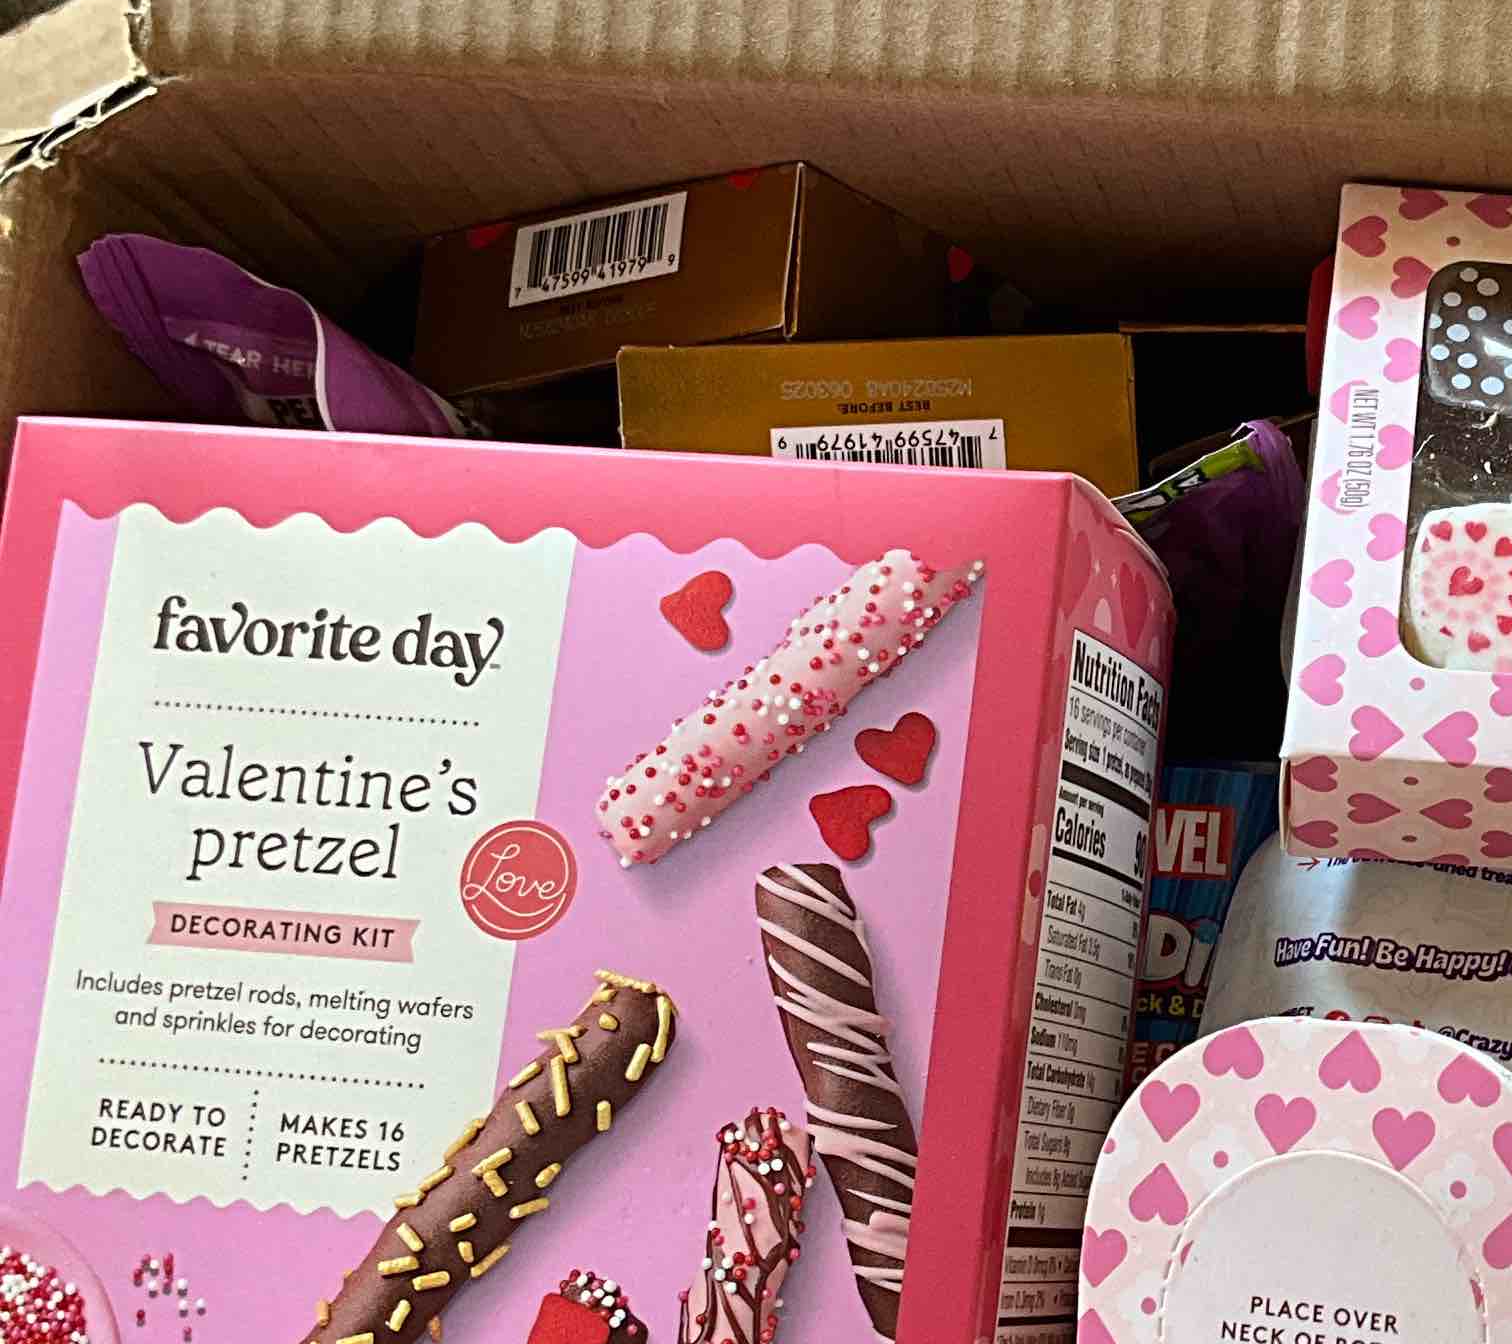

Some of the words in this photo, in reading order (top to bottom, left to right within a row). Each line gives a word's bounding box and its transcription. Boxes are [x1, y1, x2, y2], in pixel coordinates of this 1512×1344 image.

[273, 358, 316, 379] HE
[1353, 388, 1379, 410] NET
[1352, 413, 1376, 430] WT
[1348, 435, 1375, 458] 1.76
[1346, 461, 1372, 476] OZ
[1340, 478, 1370, 507] (50g)
[153, 595, 382, 662] favorite
[393, 613, 504, 686] day
[1073, 640, 1135, 709] Nutrition
[1055, 808, 1106, 858] Calories
[1155, 808, 1227, 876] VEL
[186, 823, 400, 880] pretzel
[463, 843, 568, 902] Love
[170, 913, 341, 945] DECORATING
[352, 926, 396, 948] KIT
[1275, 938, 1312, 964] Have
[1314, 935, 1370, 961] Fun!
[1375, 943, 1408, 967] Be
[1415, 946, 1506, 977] Happy!
[76, 970, 163, 998] Includes
[169, 979, 241, 1005] pretzel
[248, 987, 302, 1010] rods,
[309, 991, 390, 1019] melting
[398, 996, 474, 1020] wafers
[115, 1008, 156, 1028] and
[162, 1011, 256, 1037] sprinkles
[263, 1017, 294, 1038] for
[299, 1023, 422, 1054] decorating
[99, 1098, 183, 1124] READY
[193, 1106, 226, 1128] TO
[280, 1114, 368, 1140] MAKES
[379, 1121, 405, 1143] 16
[91, 1127, 226, 1157] DECORATE
[277, 1143, 400, 1173] PRETZELS
[1250, 1296, 1324, 1323] PLACE
[1334, 1308, 1399, 1334] OVER
